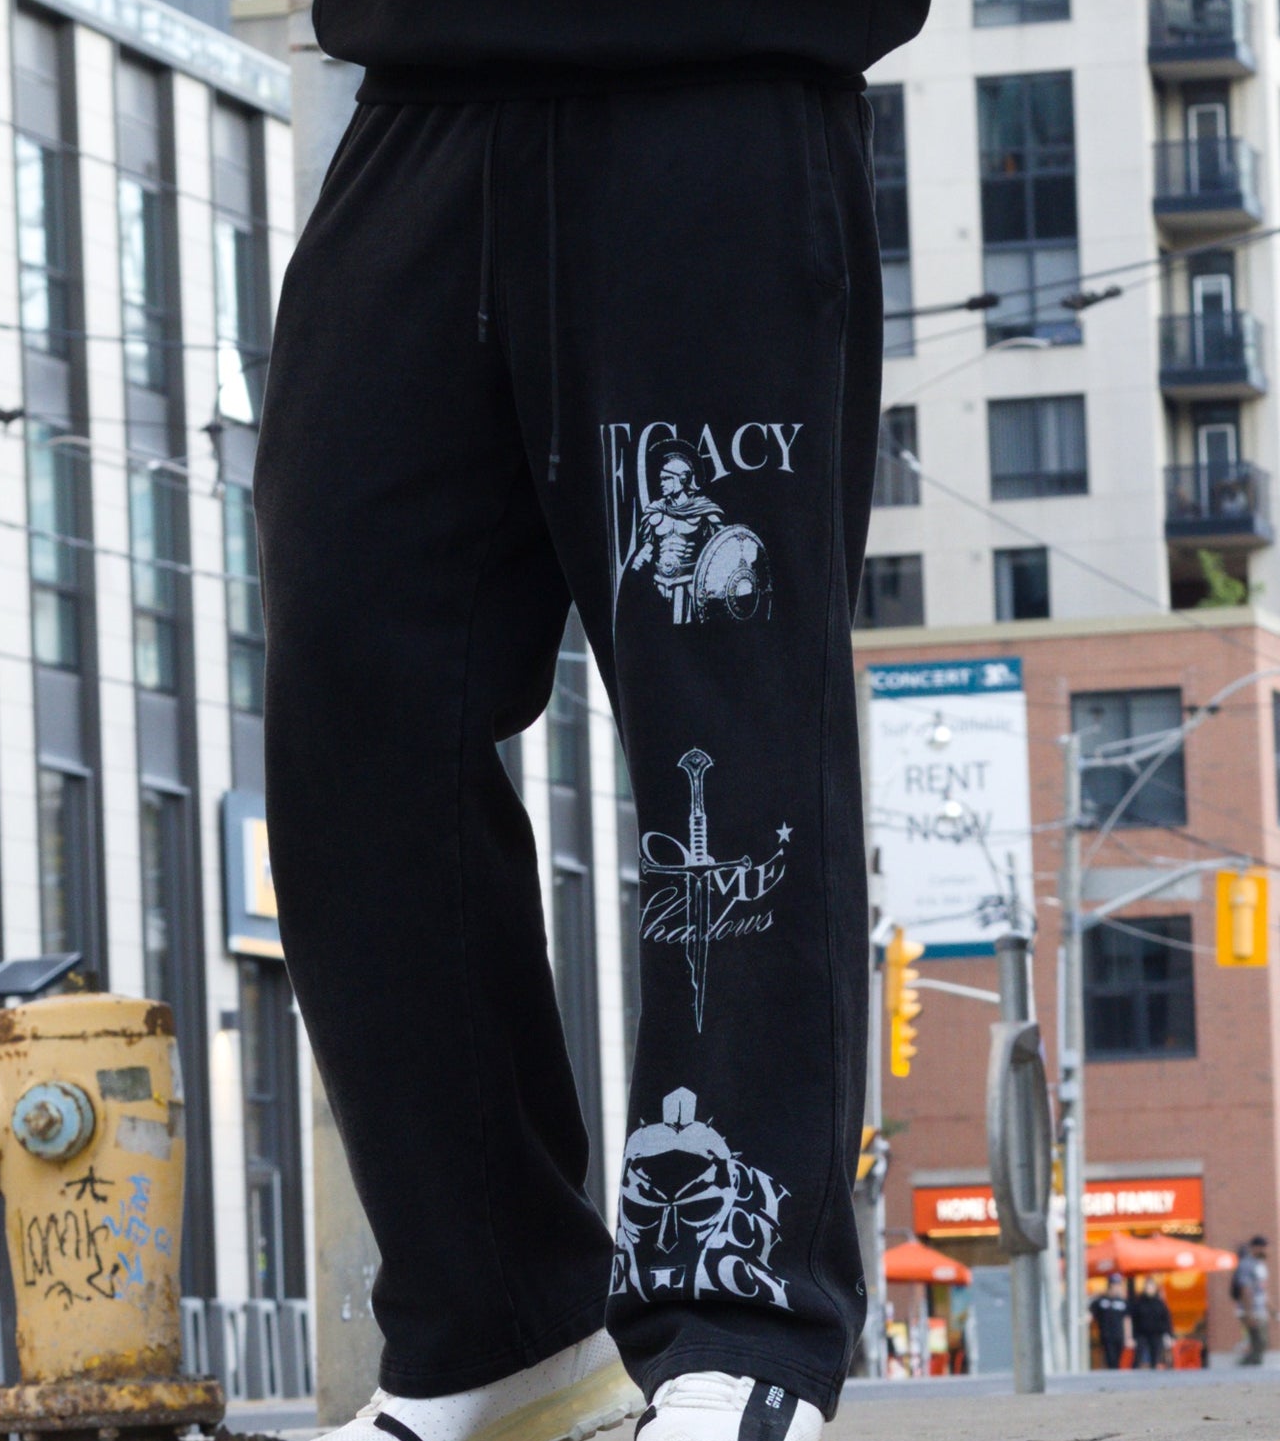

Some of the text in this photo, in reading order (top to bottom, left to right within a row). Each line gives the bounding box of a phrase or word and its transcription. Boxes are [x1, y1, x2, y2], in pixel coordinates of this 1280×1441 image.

[871, 667, 972, 691] CONCERT
[905, 760, 991, 795] RENT
[906, 811, 993, 844] NOW
[936, 1198, 987, 1221] HOME
[1117, 1190, 1176, 1214] FAMILY
